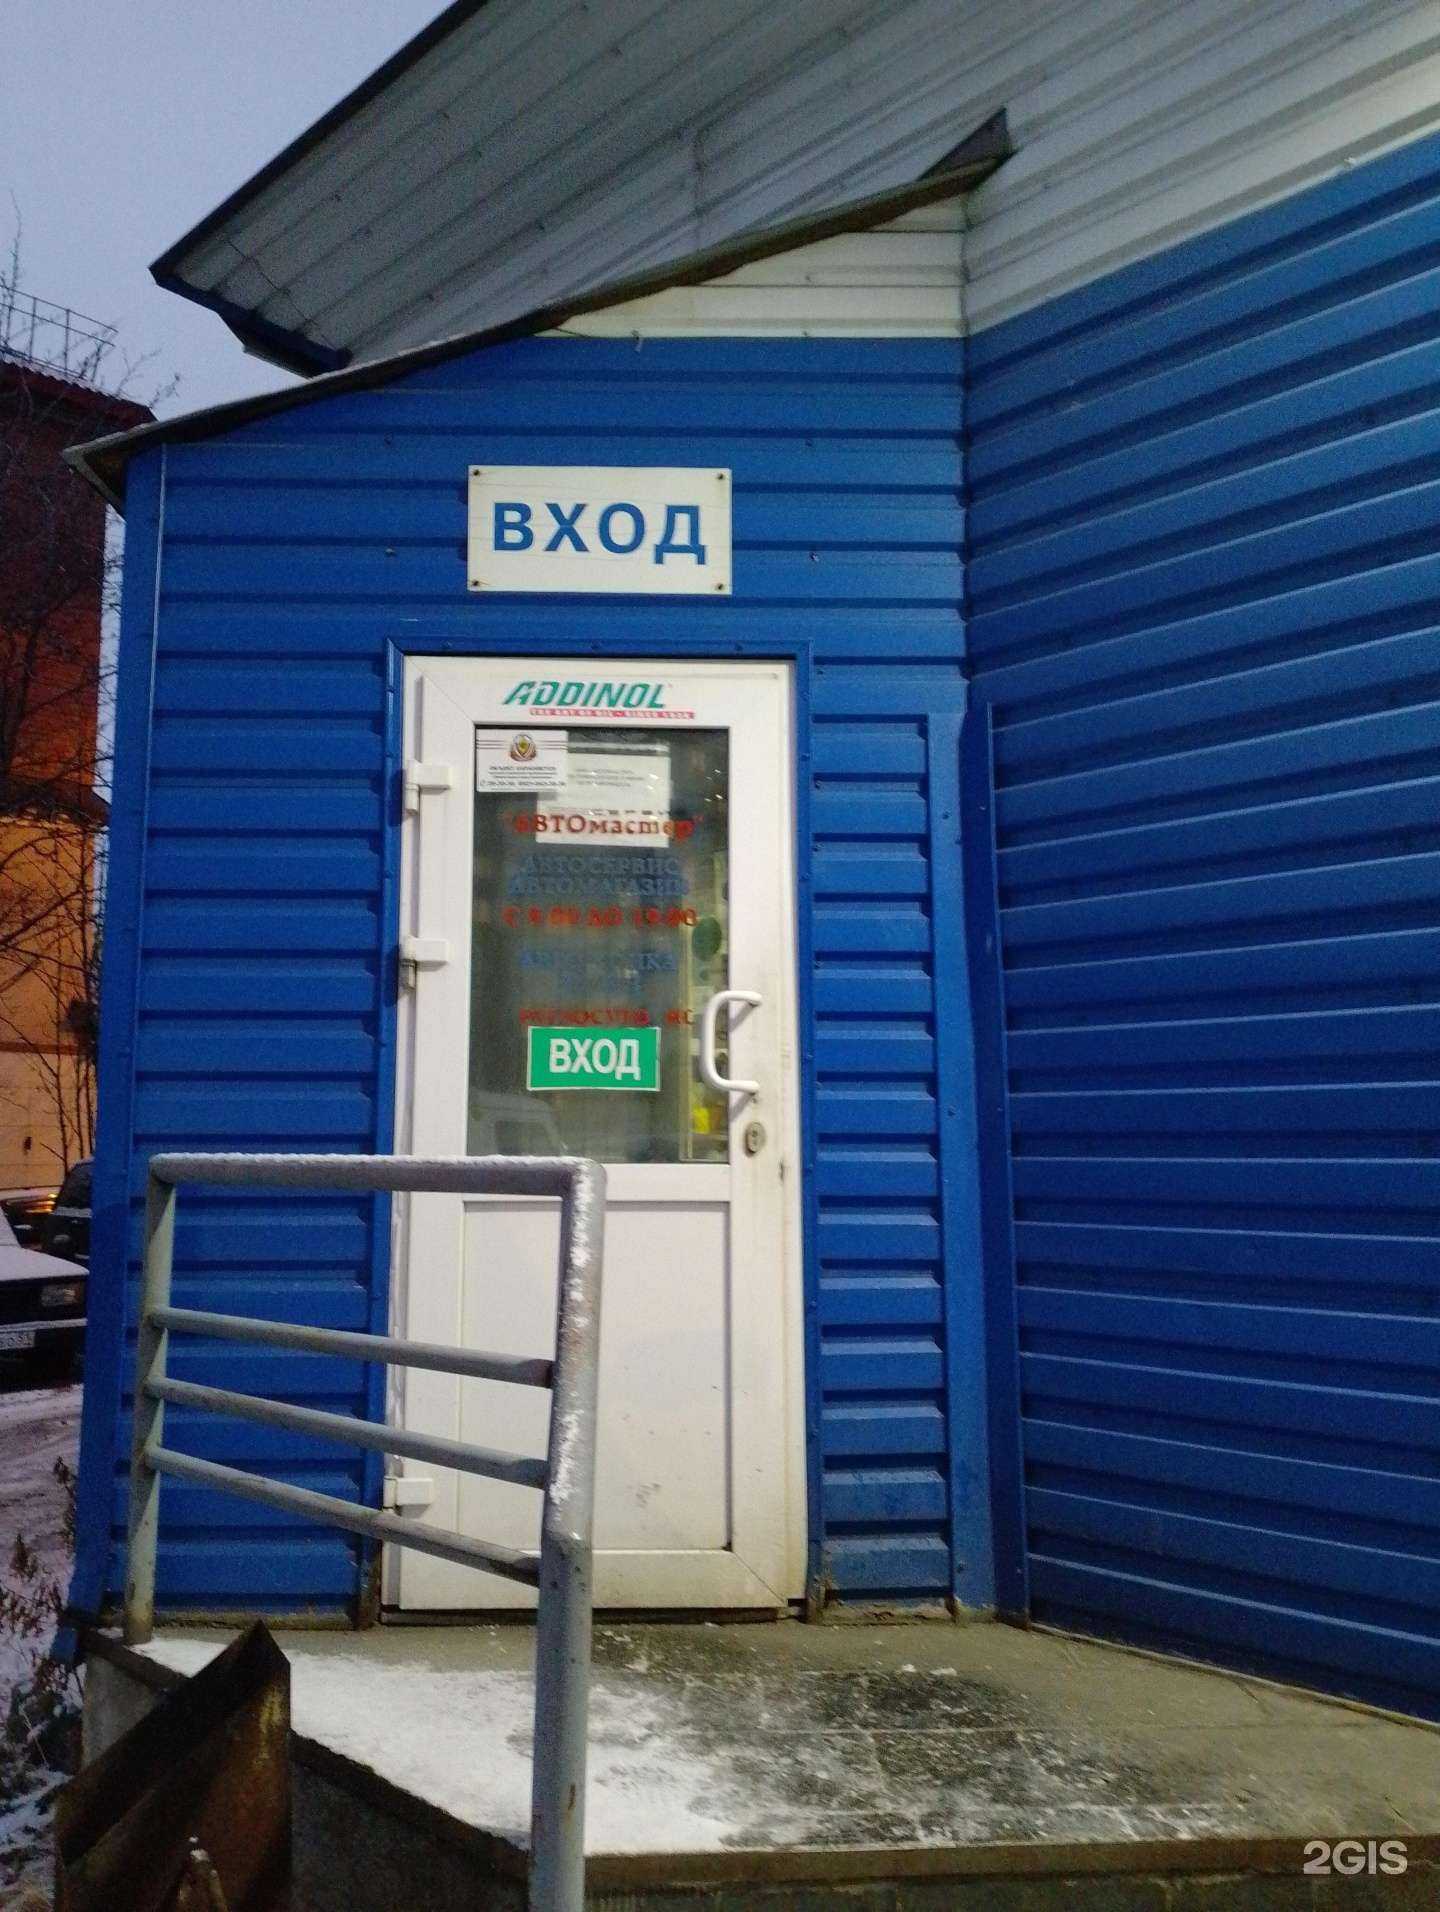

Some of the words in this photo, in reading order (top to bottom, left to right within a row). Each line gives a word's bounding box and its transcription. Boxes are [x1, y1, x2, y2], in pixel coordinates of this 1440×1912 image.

[493, 502, 706, 565] ВХОД
[503, 681, 667, 708] ADDINOL
[549, 1038, 641, 1081] ВХОД
